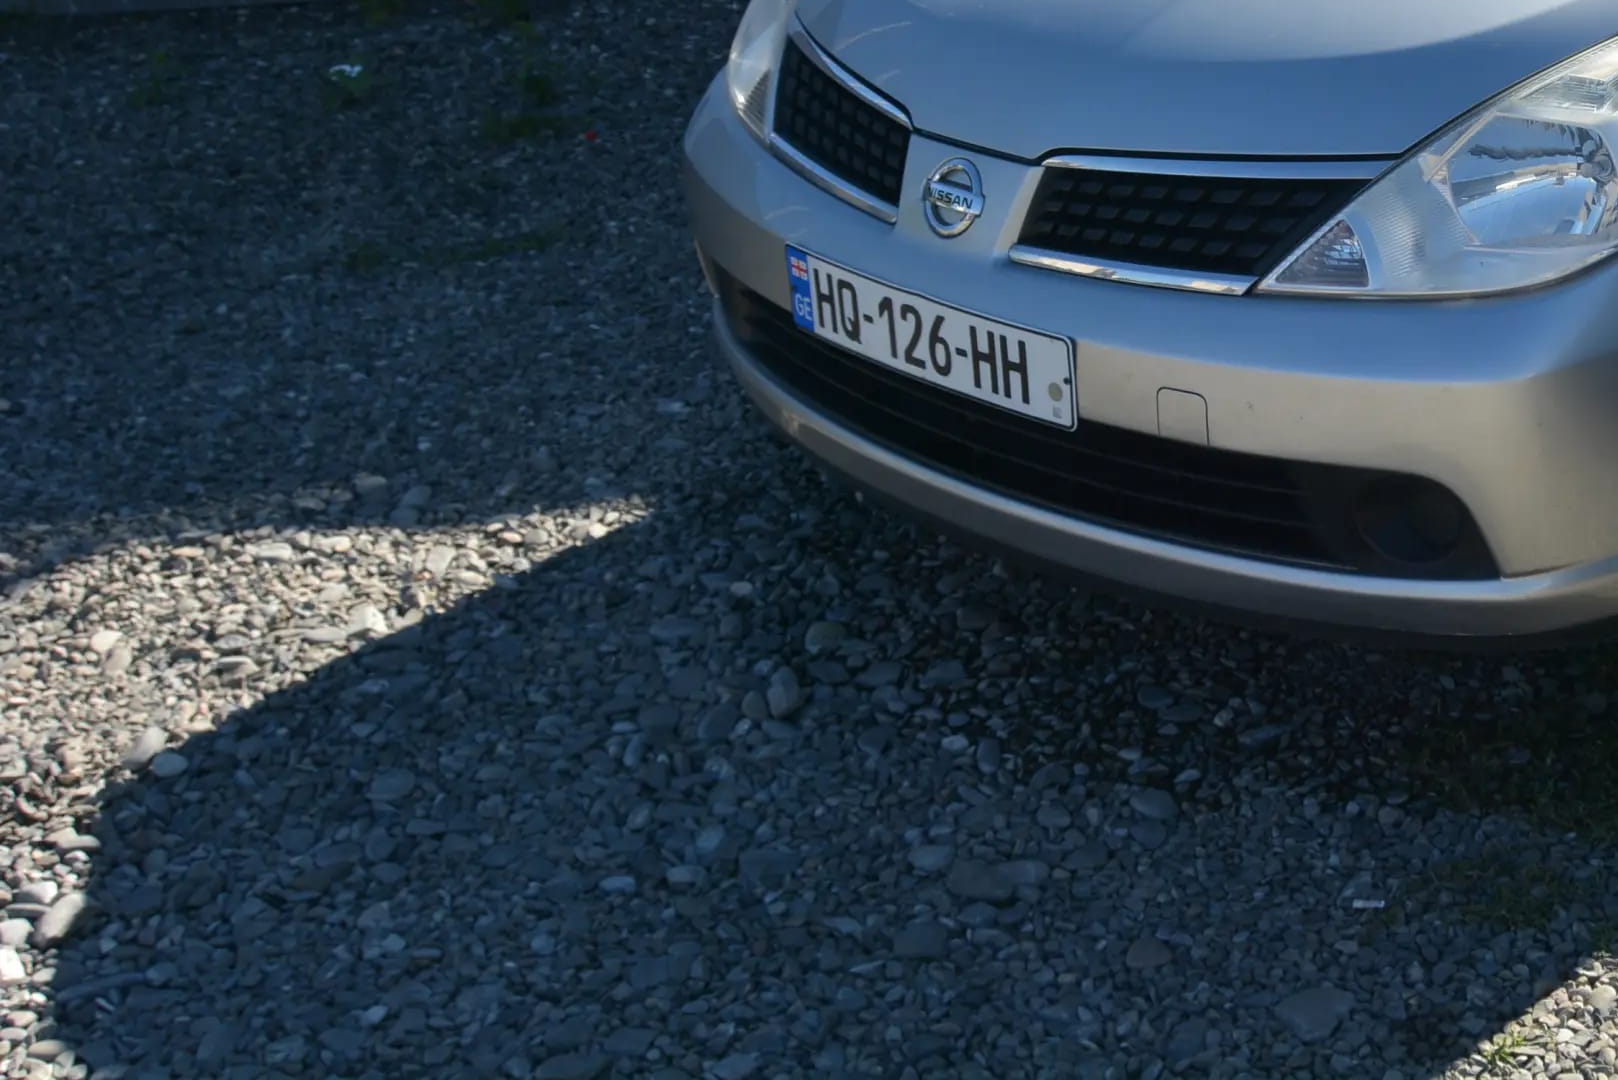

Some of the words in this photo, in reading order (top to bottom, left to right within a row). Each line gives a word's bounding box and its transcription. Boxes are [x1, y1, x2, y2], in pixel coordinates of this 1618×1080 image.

[928, 185, 973, 209] NISSAN
[794, 292, 812, 321] GE
[813, 268, 1031, 405] HQ-126-HH
